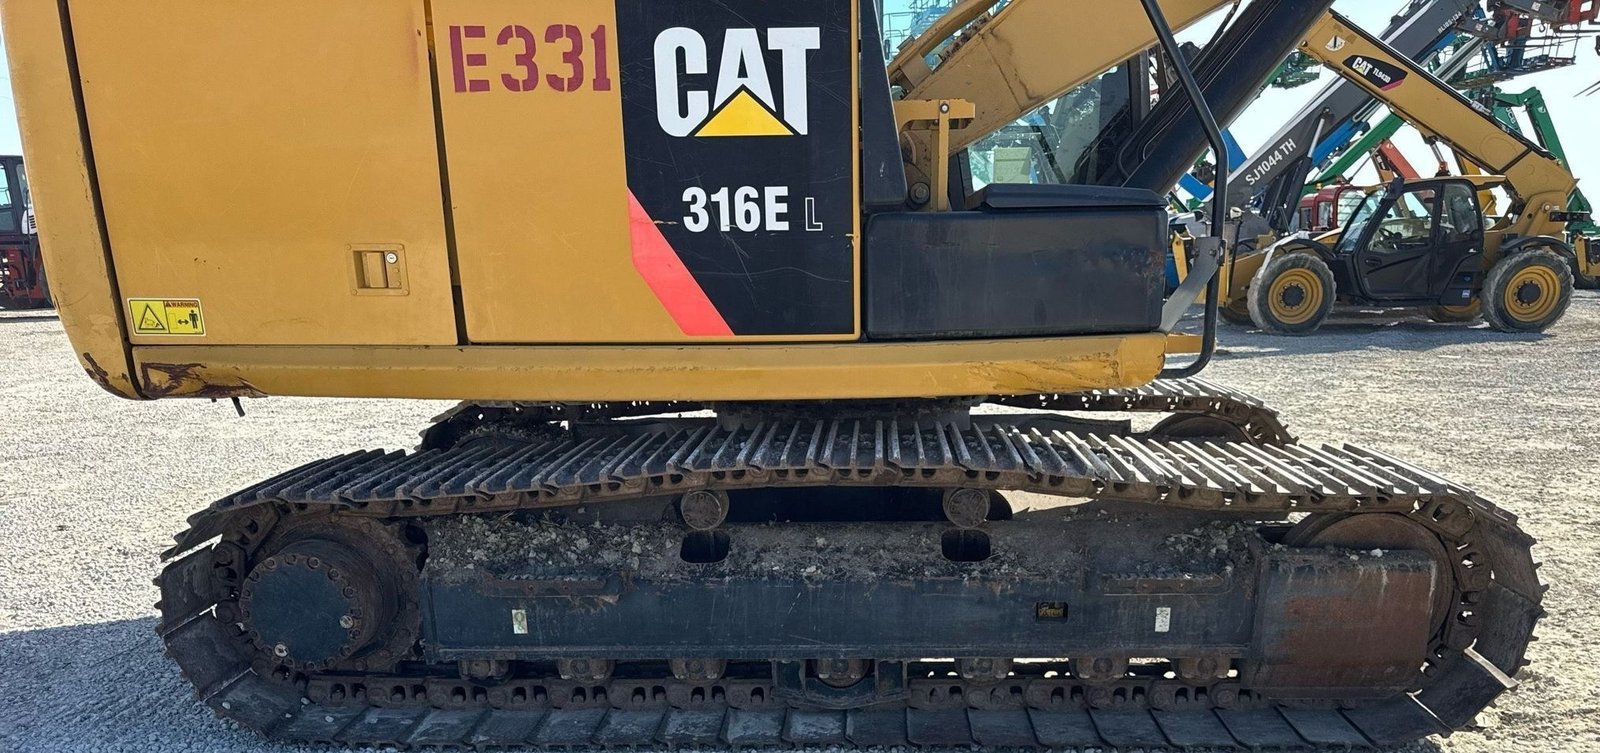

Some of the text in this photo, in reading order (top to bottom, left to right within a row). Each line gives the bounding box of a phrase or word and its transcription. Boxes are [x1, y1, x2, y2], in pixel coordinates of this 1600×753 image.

[449, 24, 611, 92] E331
[653, 26, 821, 137] CAT
[1352, 56, 1374, 76] CAT
[1245, 138, 1297, 186] SJ1044 TH
[682, 185, 823, 233] 316E L
